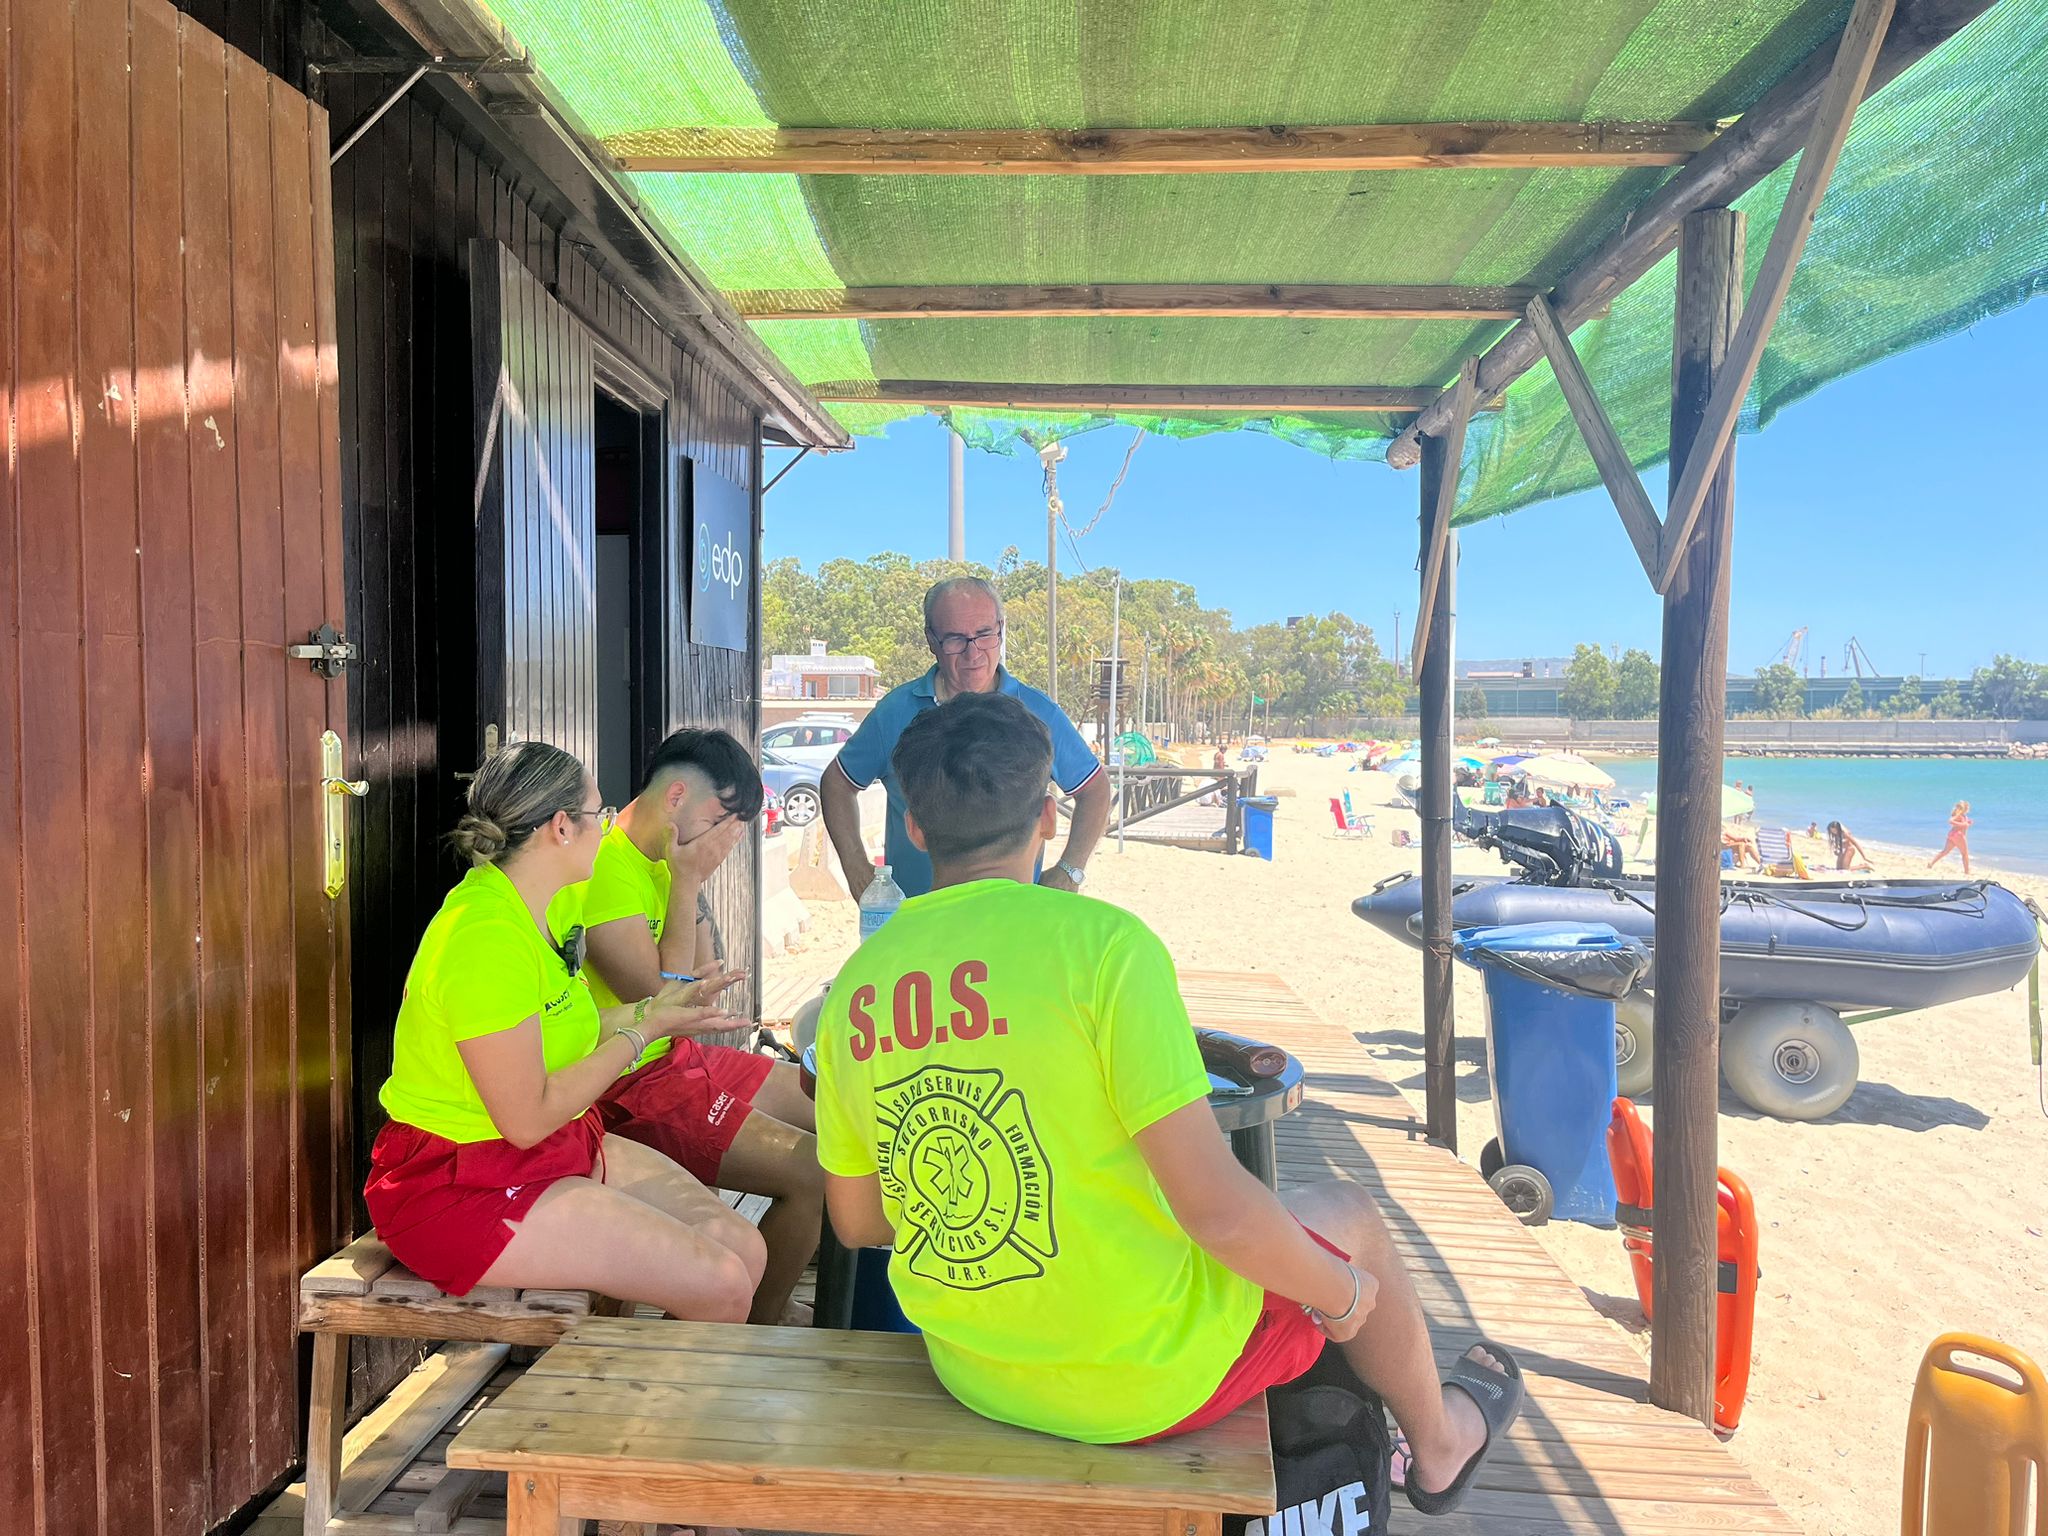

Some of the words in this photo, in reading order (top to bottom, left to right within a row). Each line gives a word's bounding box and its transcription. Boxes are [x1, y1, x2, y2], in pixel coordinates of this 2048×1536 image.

[712, 530, 743, 601] edp
[848, 959, 1009, 1062] S.O.S.
[897, 1106, 993, 1156] SOCORRISMO
[1005, 1123, 1043, 1222] FORMACIÓN
[910, 1201, 987, 1252] SERVICIOS
[983, 1201, 1008, 1232] S.L.
[947, 1265, 992, 1281] U.R.P.
[1244, 1481, 1370, 1536] KE
